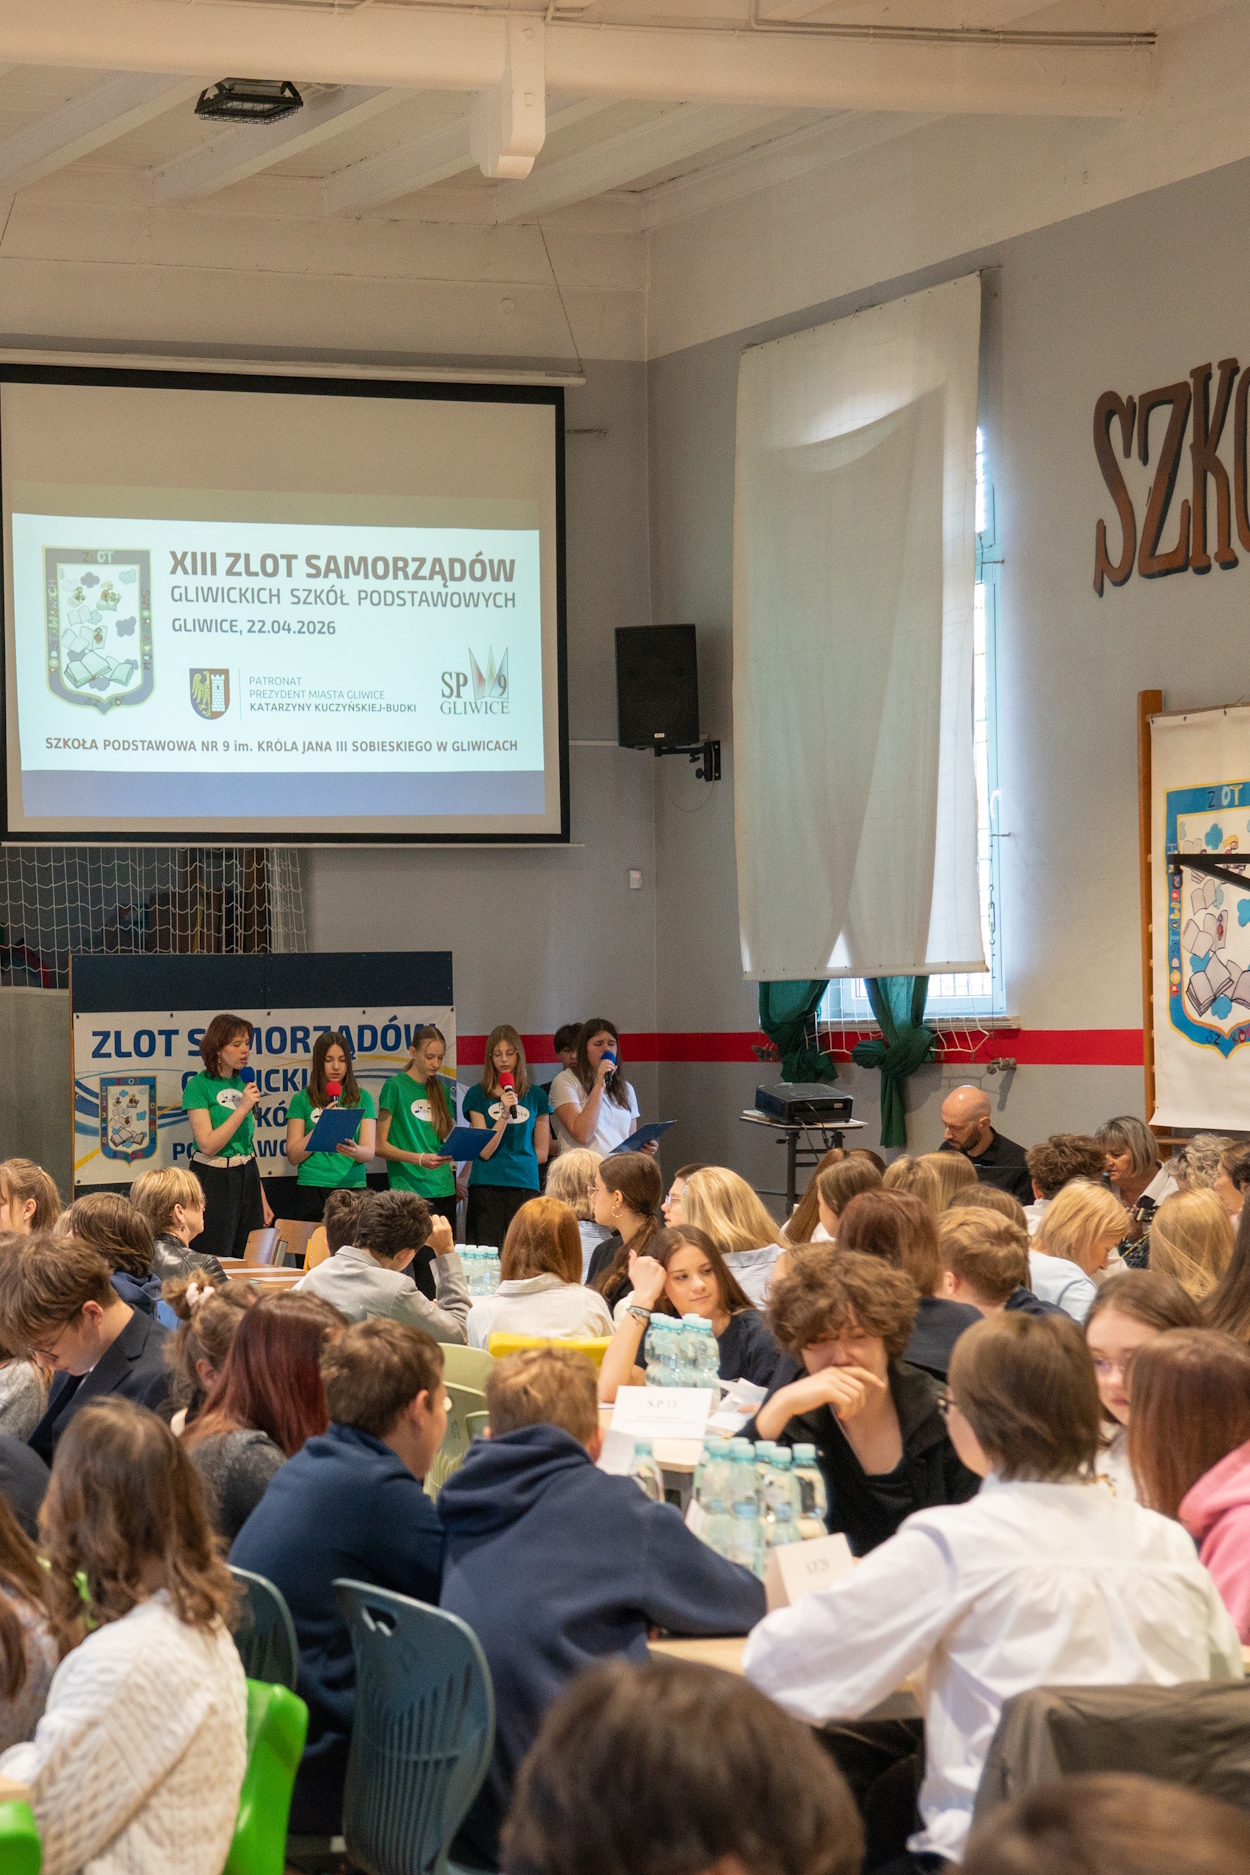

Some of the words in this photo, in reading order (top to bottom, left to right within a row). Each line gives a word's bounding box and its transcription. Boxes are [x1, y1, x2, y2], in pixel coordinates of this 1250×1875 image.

[170, 551, 217, 576] XIII
[226, 553, 298, 578] ZLOT
[305, 550, 516, 588] SAMORZĄDÓW
[171, 586, 280, 604] GLIWICKICH
[291, 585, 349, 605] SZKÓŁ
[358, 590, 515, 608] PODSTAWOWYCH
[172, 618, 242, 635] GLIWICE,
[247, 620, 335, 634] 22.04.2026
[249, 677, 301, 685] PATRONAT
[441, 672, 468, 698] SP
[250, 690, 306, 698] PREZYDENT
[309, 690, 344, 699] MIASTA
[347, 690, 385, 699] GLIWICE
[250, 703, 311, 711] KATARZYNY
[315, 701, 416, 712] KUCZYŃSKIEJ-BUDKI
[440, 701, 509, 714] GLIWICE
[46, 738, 98, 750] SZKOŁA
[104, 740, 196, 751] PODSTAWOWA
[202, 741, 218, 751] NR
[223, 741, 229, 751] 9
[235, 740, 252, 751] im.
[257, 737, 298, 752] KRÓLA
[302, 741, 332, 754] JANA
[337, 741, 347, 751] III
[352, 741, 432, 751] SOBIESKIEGO
[437, 741, 447, 751] W
[452, 740, 517, 751] GLIWICACH
[92, 1029, 179, 1058] ZLOT
